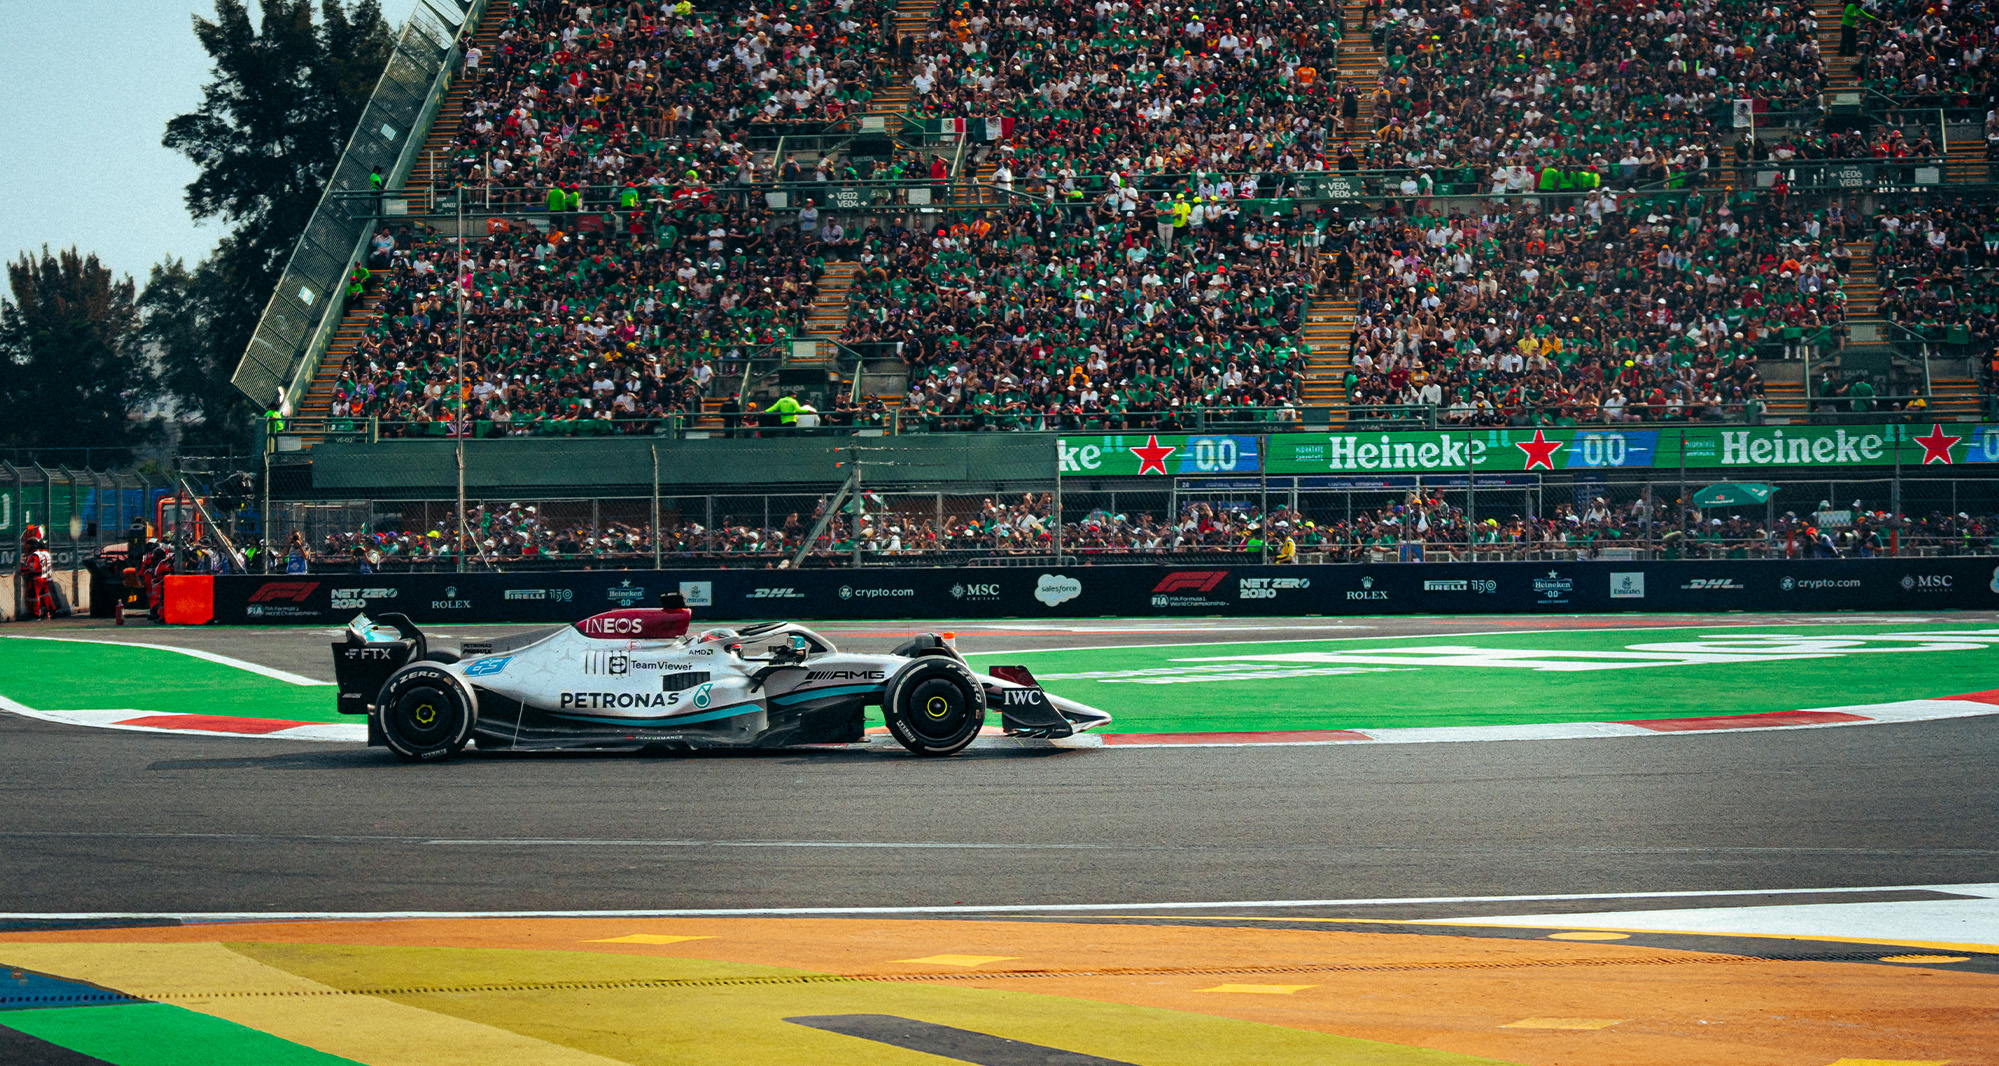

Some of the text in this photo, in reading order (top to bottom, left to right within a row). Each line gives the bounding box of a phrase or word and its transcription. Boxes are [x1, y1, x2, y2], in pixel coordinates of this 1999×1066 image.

[1839, 170, 1862, 178] VE06
[1327, 182, 1351, 190] VE04
[836, 192, 858, 200] VE02
[1328, 190, 1351, 198] VE06
[836, 200, 859, 208] VE04
[1240, 578, 1310, 588] NET ZERO
[1535, 581, 1571, 589] Heineken
[1689, 579, 1735, 589] DHL
[1798, 578, 1861, 589] crypto.com
[1917, 575, 1953, 587] MSC
[331, 588, 398, 599] NET ZERO
[754, 588, 797, 598] DHL
[855, 587, 914, 598] crypto.com
[967, 584, 1000, 596] MSC
[1041, 585, 1077, 593] salesforce
[1240, 588, 1277, 599] 2030
[1346, 591, 1388, 600] ROLEX
[331, 599, 367, 609] 2030
[432, 600, 472, 608] ROLEX
[1151, 597, 1167, 605] FIA
[585, 618, 643, 633] INEOS
[361, 648, 391, 660] FTX
[399, 670, 440, 684] ZERO
[829, 671, 885, 680] AMG
[560, 692, 680, 709] PETRONAS
[1003, 690, 1041, 706] IWC
